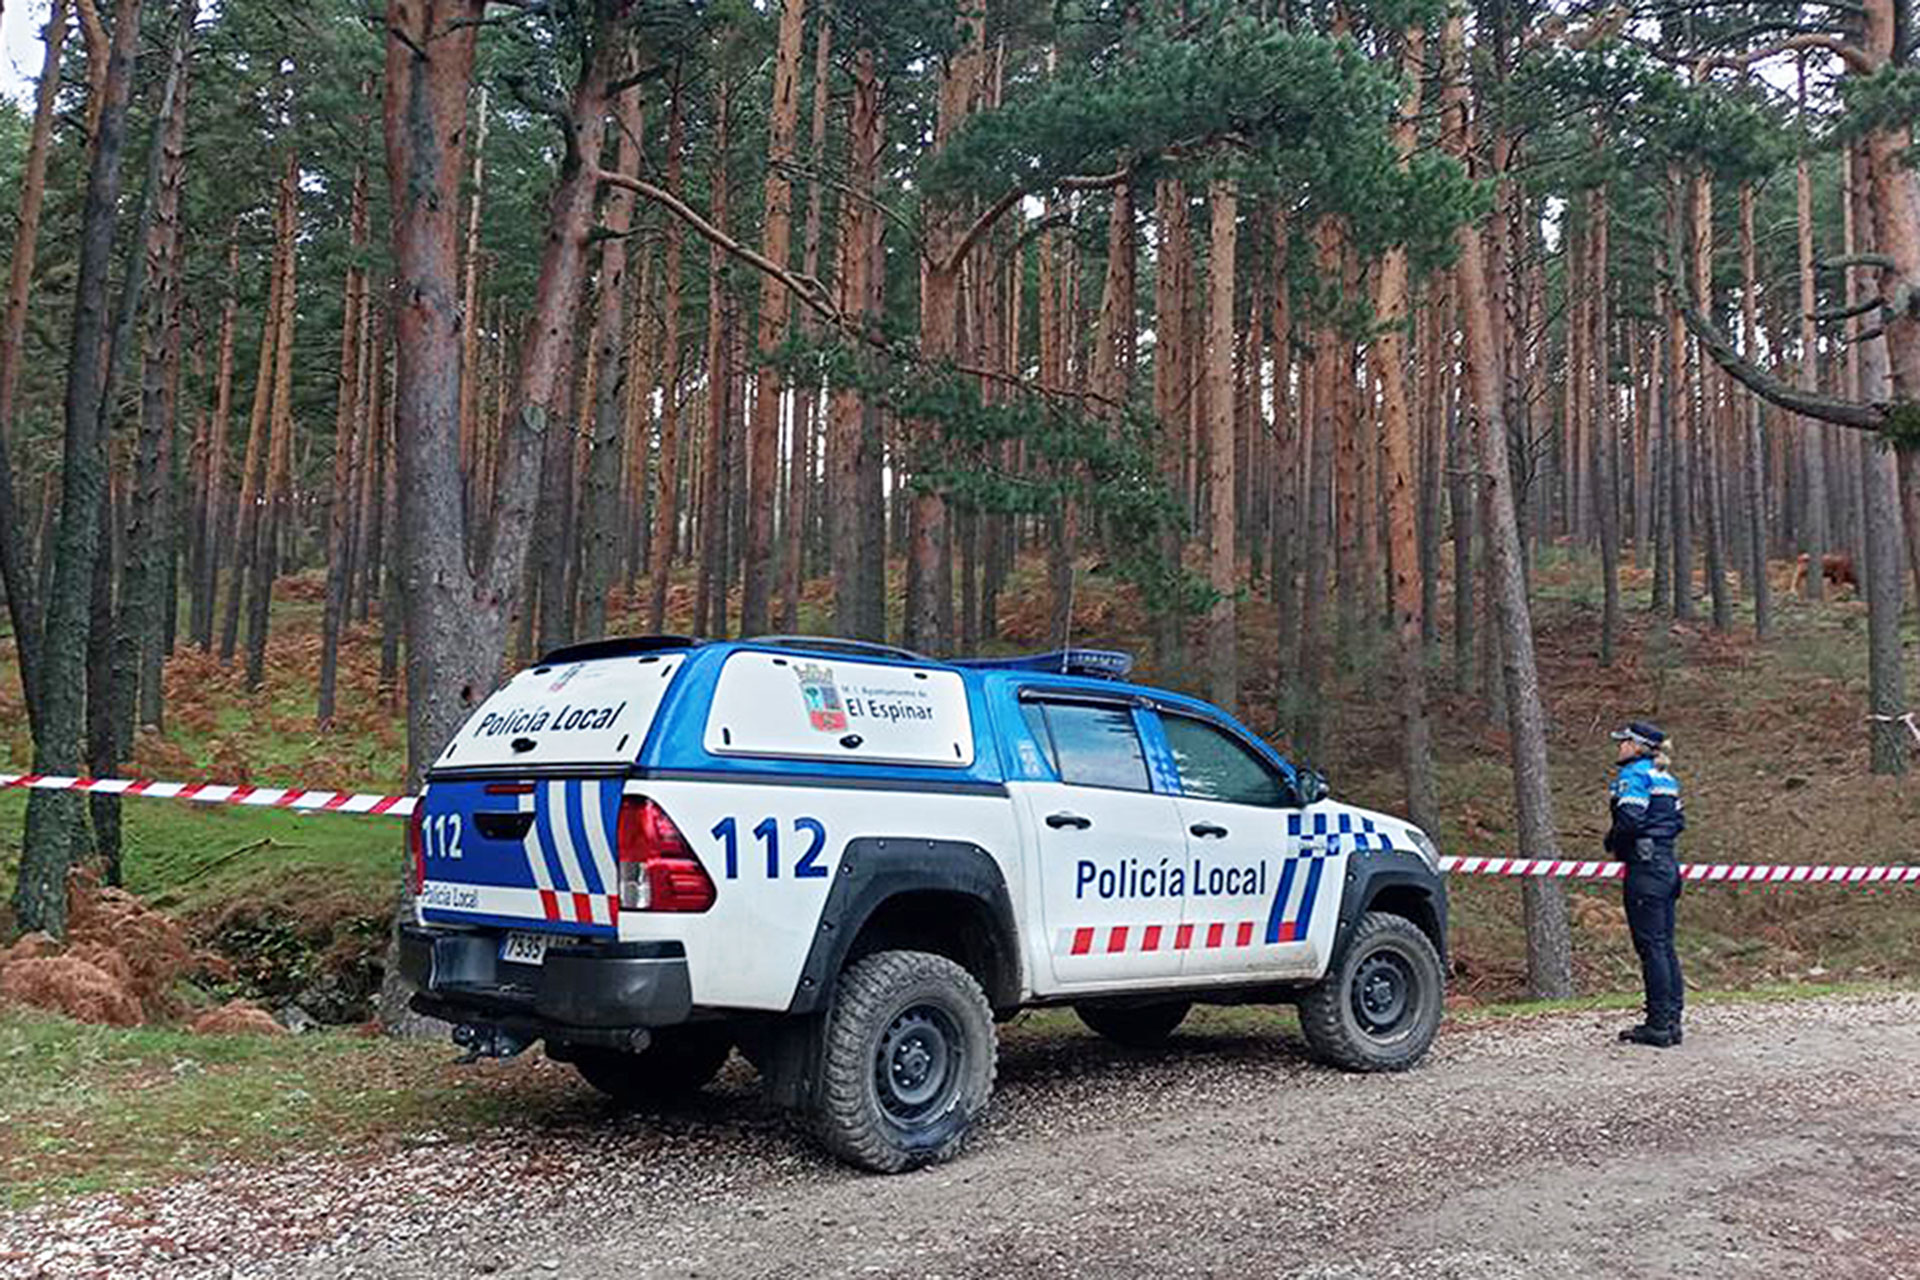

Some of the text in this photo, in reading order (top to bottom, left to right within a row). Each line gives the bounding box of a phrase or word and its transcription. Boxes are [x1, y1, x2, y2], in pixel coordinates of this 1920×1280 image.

[473, 701, 627, 739] Policía Local
[846, 698, 933, 723] El Espinar
[422, 813, 463, 858] 112
[711, 817, 829, 879] 112
[1076, 857, 1265, 899] Policía Local
[453, 887, 480, 909] Local
[508, 933, 543, 959] 7535
